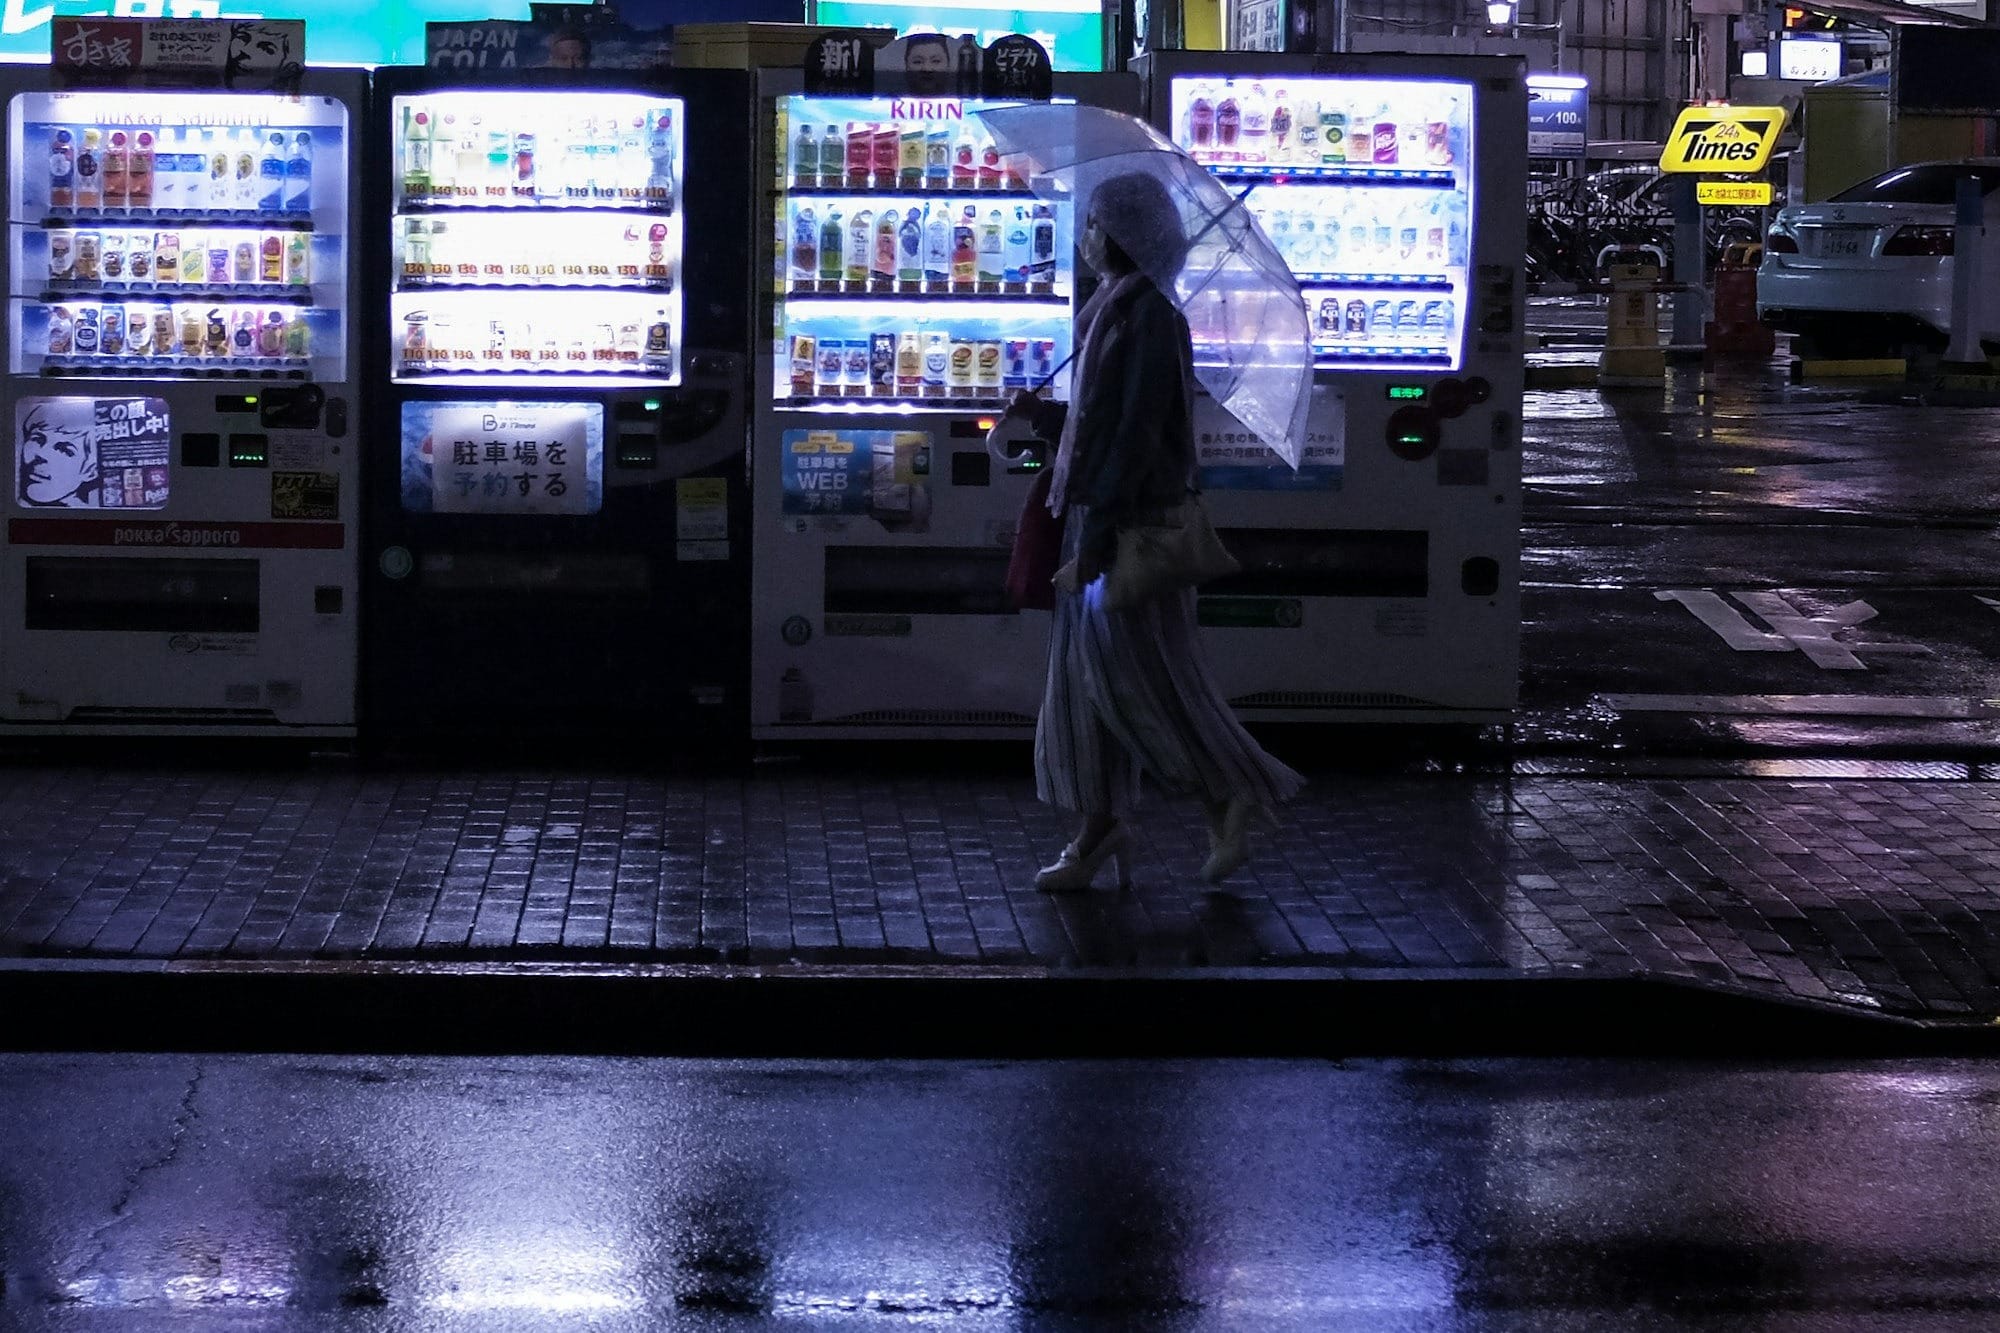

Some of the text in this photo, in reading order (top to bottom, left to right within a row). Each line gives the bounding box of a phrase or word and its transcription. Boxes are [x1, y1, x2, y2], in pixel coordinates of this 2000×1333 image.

[62, 23, 132, 67] すき家
[436, 28, 519, 48] JAPAN
[890, 100, 963, 120] KIRIN
[1682, 133, 1760, 163] Times
[453, 440, 567, 466] 駐車場を
[453, 472, 567, 497] 予約する
[796, 471, 849, 491] WEB
[114, 527, 240, 546] pokka sapporo
